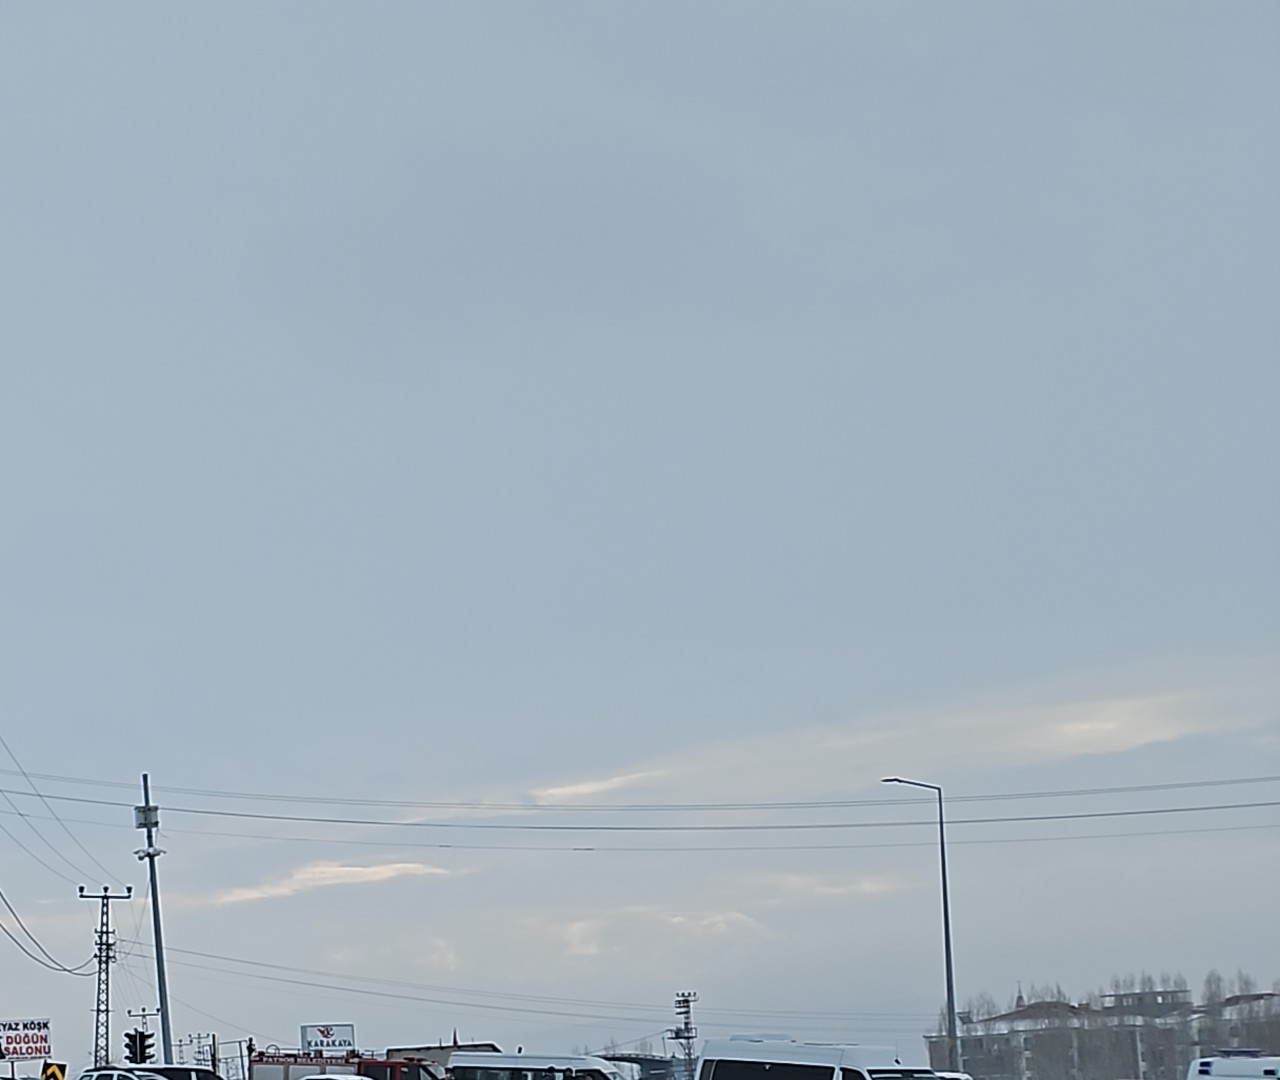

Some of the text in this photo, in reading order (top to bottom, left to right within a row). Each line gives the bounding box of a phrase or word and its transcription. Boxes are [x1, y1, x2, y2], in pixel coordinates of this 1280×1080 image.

[22, 1020, 50, 1033] KÖŞK
[6, 1033, 49, 1045] DÜĞÜN
[307, 1039, 352, 1048] KARAKAYA
[3, 1045, 51, 1056] SALONU
